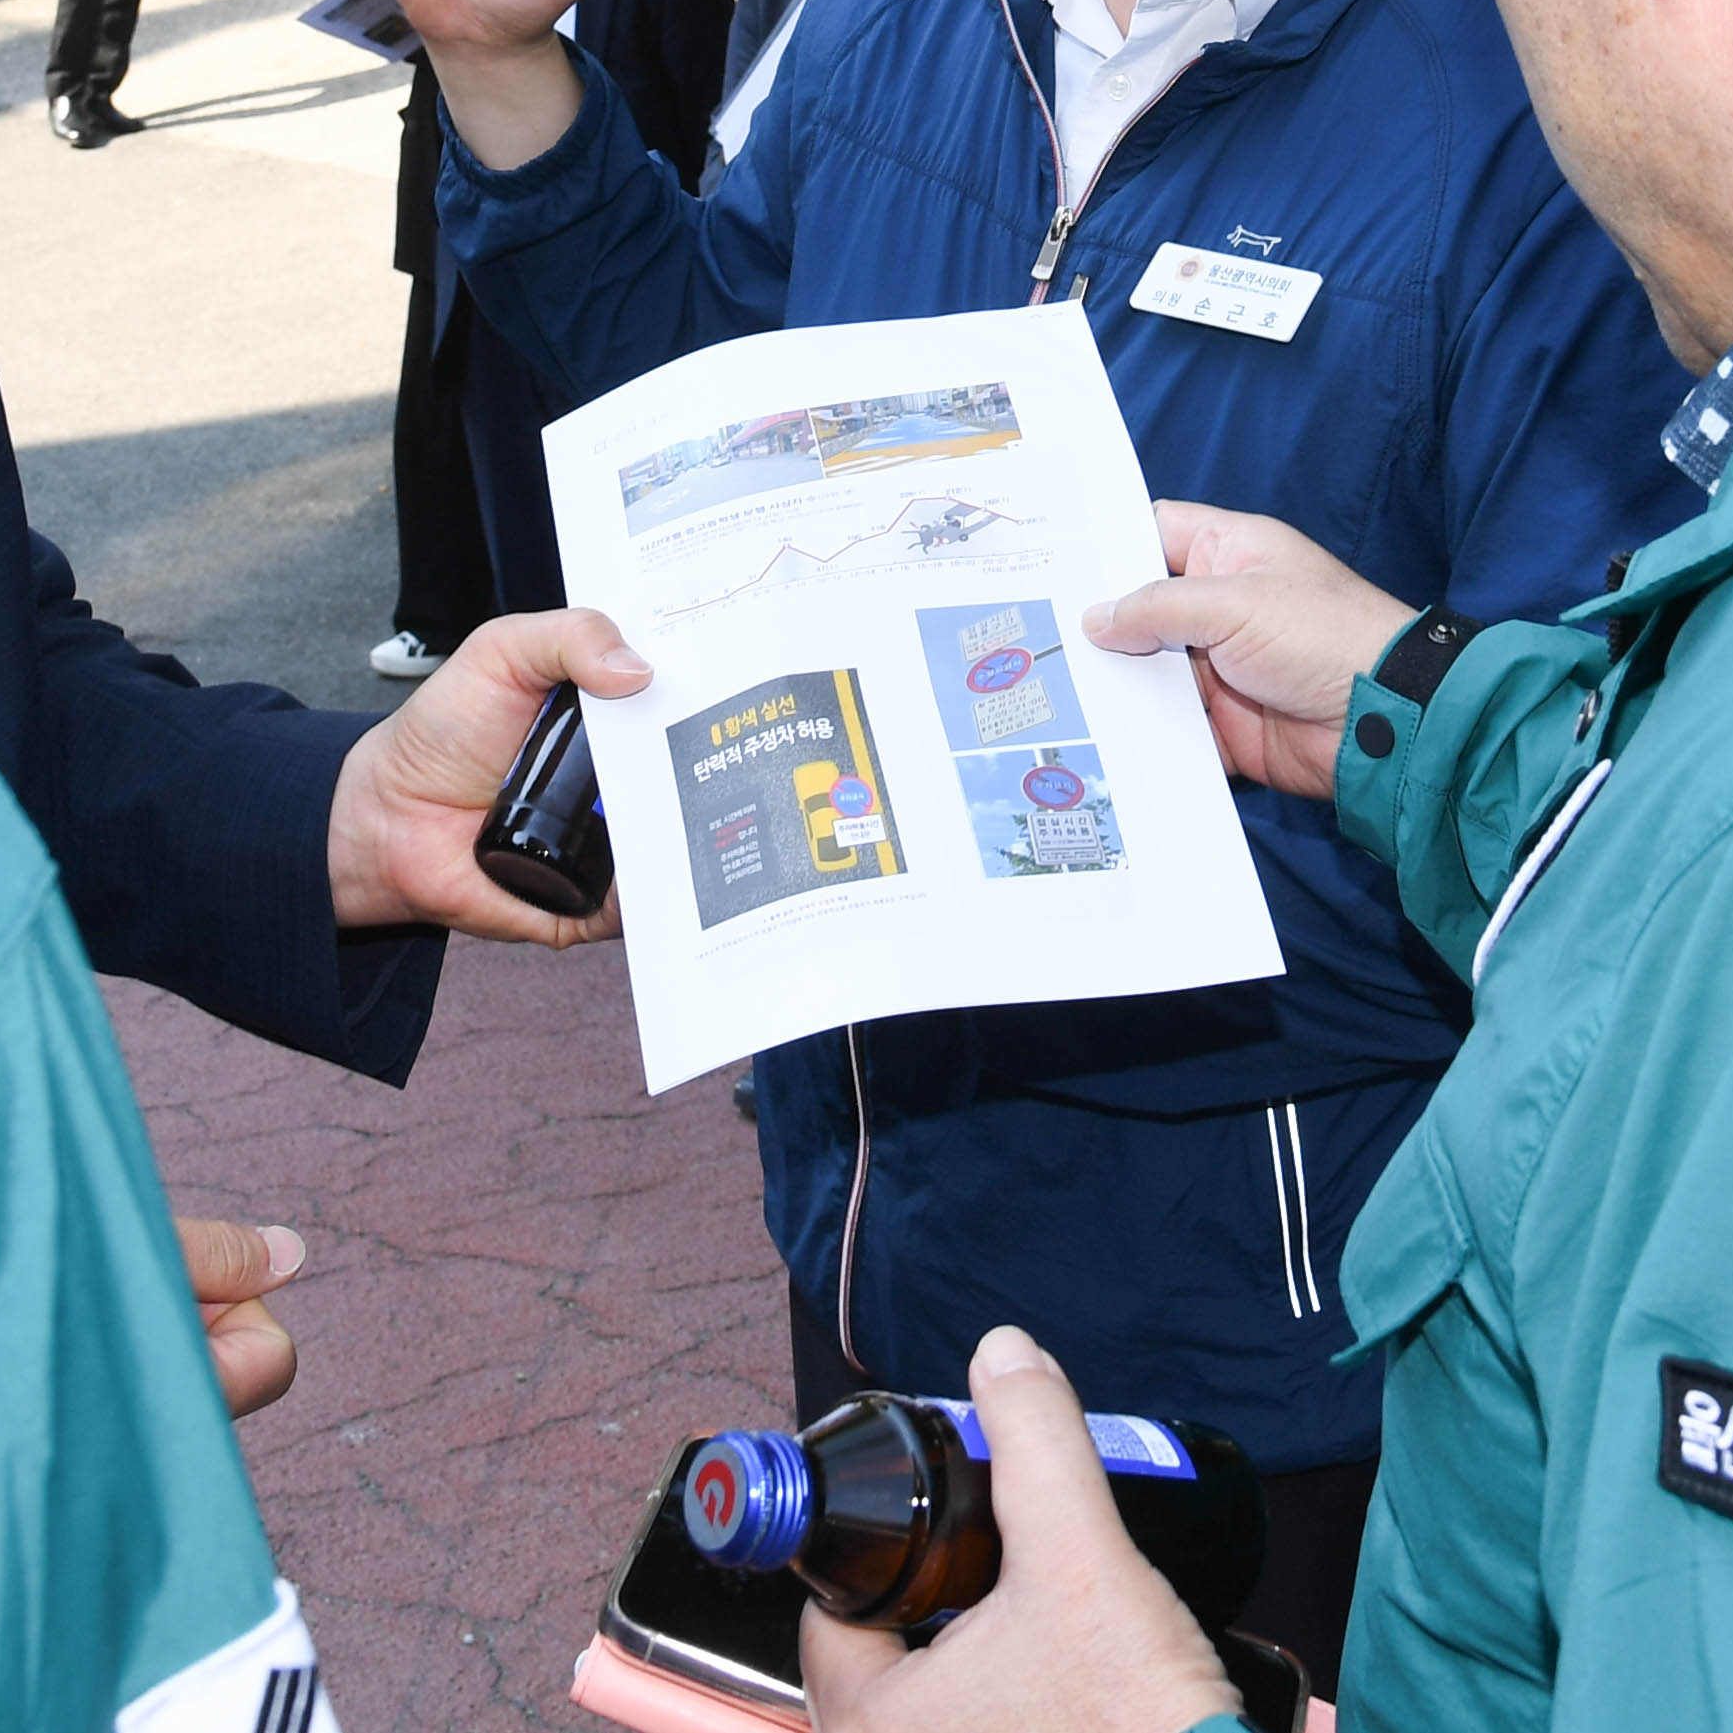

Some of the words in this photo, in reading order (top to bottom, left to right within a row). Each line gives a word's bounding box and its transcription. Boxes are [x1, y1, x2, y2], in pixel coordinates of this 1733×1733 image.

[1208, 264, 1292, 293] 울산광역시의회
[724, 706, 758, 738] 황색
[760, 693, 797, 721] 실선
[693, 743, 744, 783] 탄력적
[743, 723, 796, 758] 주정차
[795, 717, 835, 740] 허용
